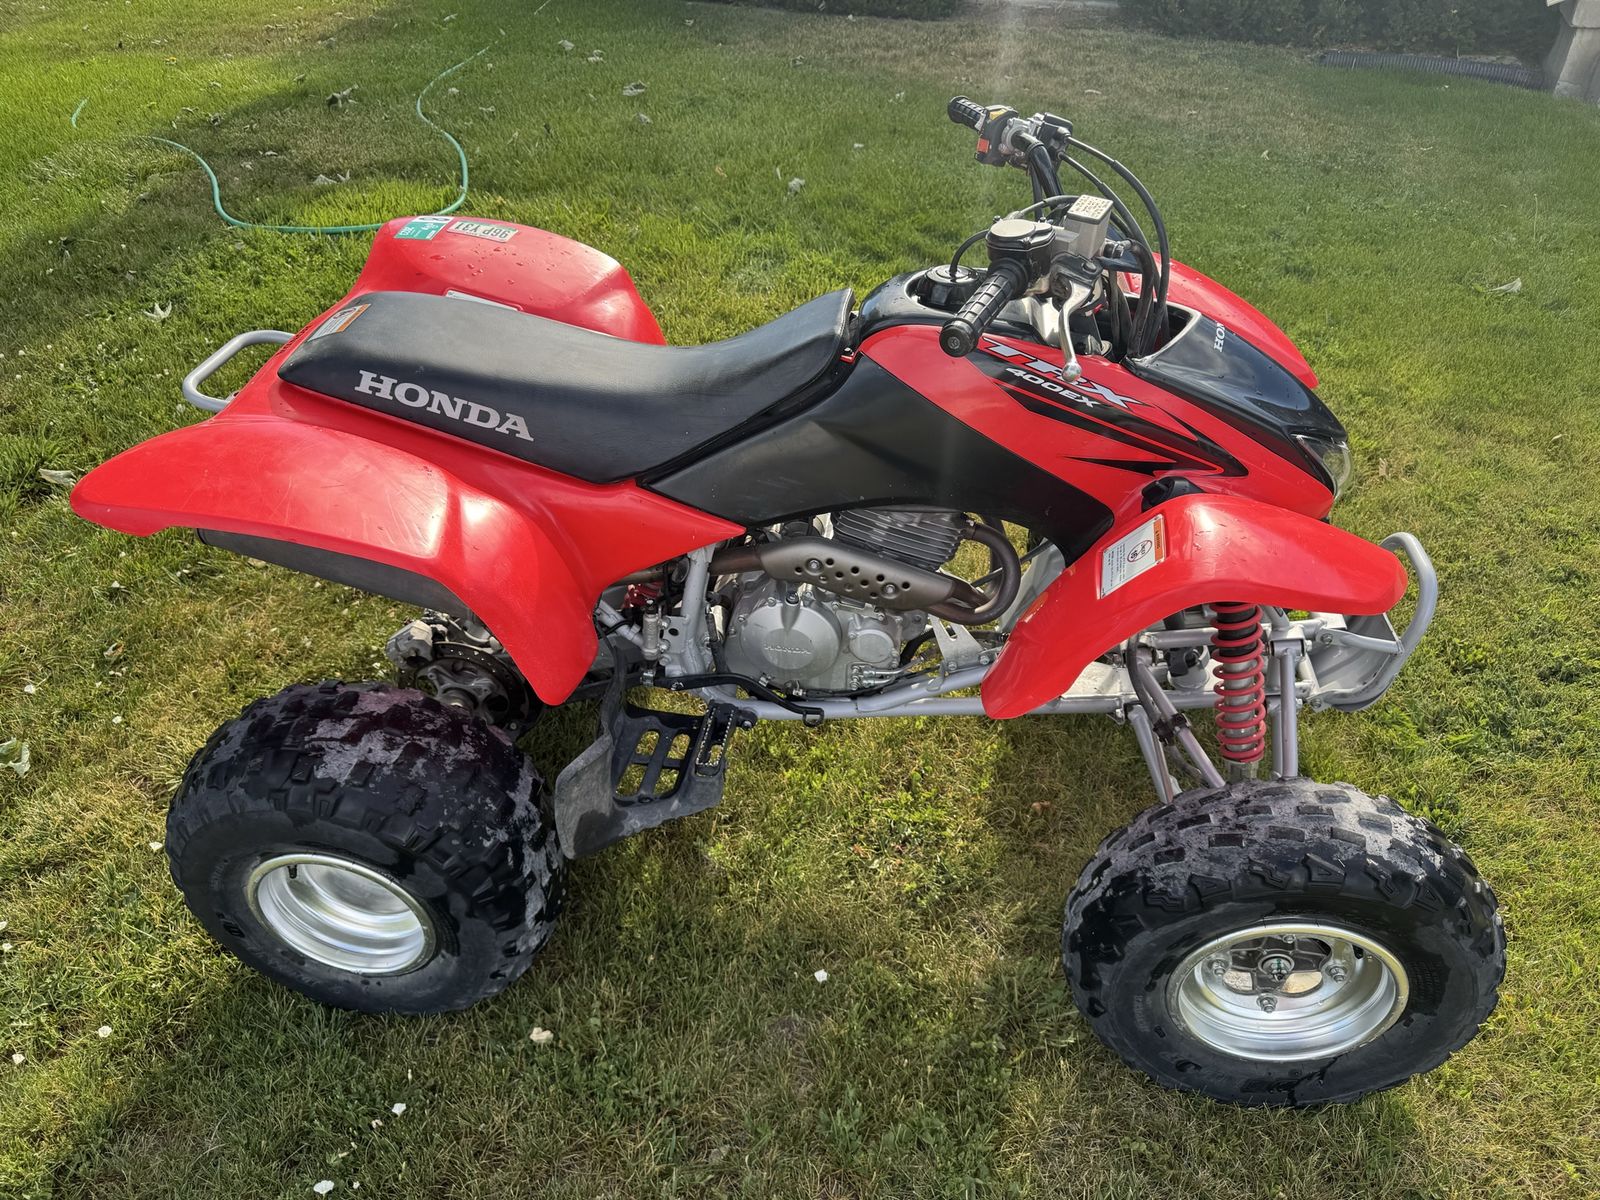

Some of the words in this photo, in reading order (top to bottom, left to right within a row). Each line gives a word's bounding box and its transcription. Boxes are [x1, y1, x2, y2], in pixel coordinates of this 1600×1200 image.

[482, 227, 511, 239] 96P
[1005, 367, 1101, 408] 400EX
[355, 369, 534, 441] HONDA
[764, 643, 812, 654] HONDA
